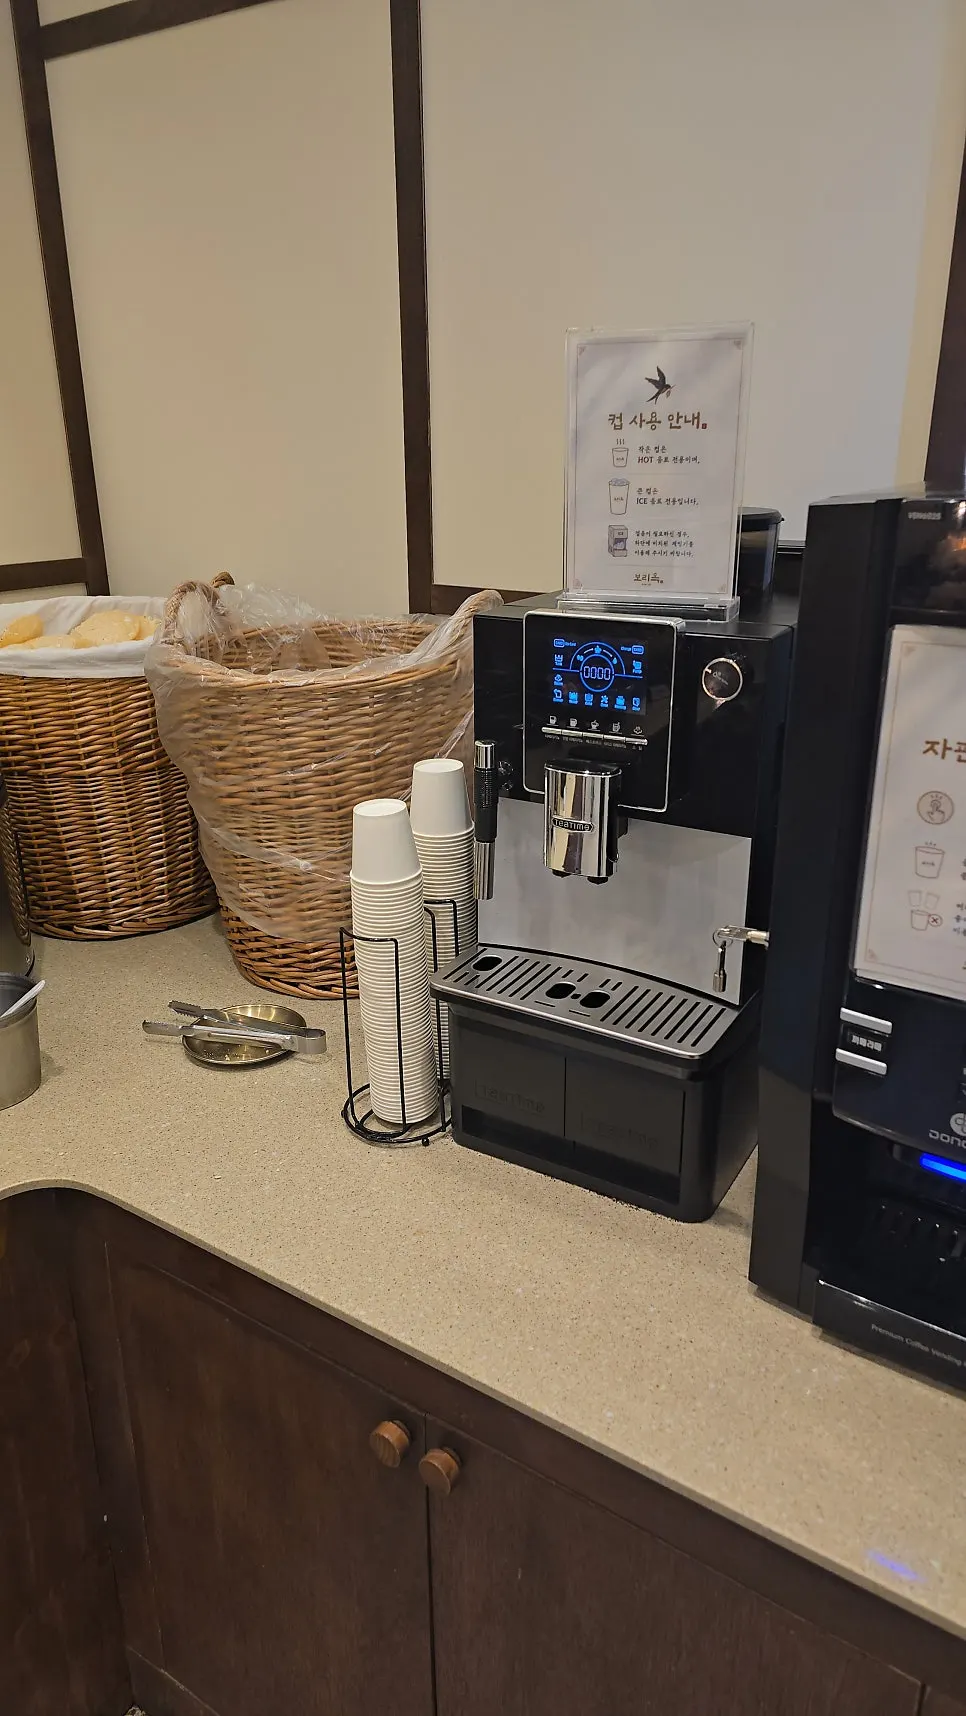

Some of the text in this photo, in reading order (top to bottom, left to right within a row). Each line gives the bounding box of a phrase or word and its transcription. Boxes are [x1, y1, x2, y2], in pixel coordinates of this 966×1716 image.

[608, 412, 623, 431] 컵
[629, 411, 662, 431] 사용
[637, 456, 654, 464] HOT
[657, 456, 669, 464] 음료
[636, 497, 648, 505] ICE
[583, 666, 611, 680] 0000
[871, 1323, 962, 1367] Premium Coffee Vending
